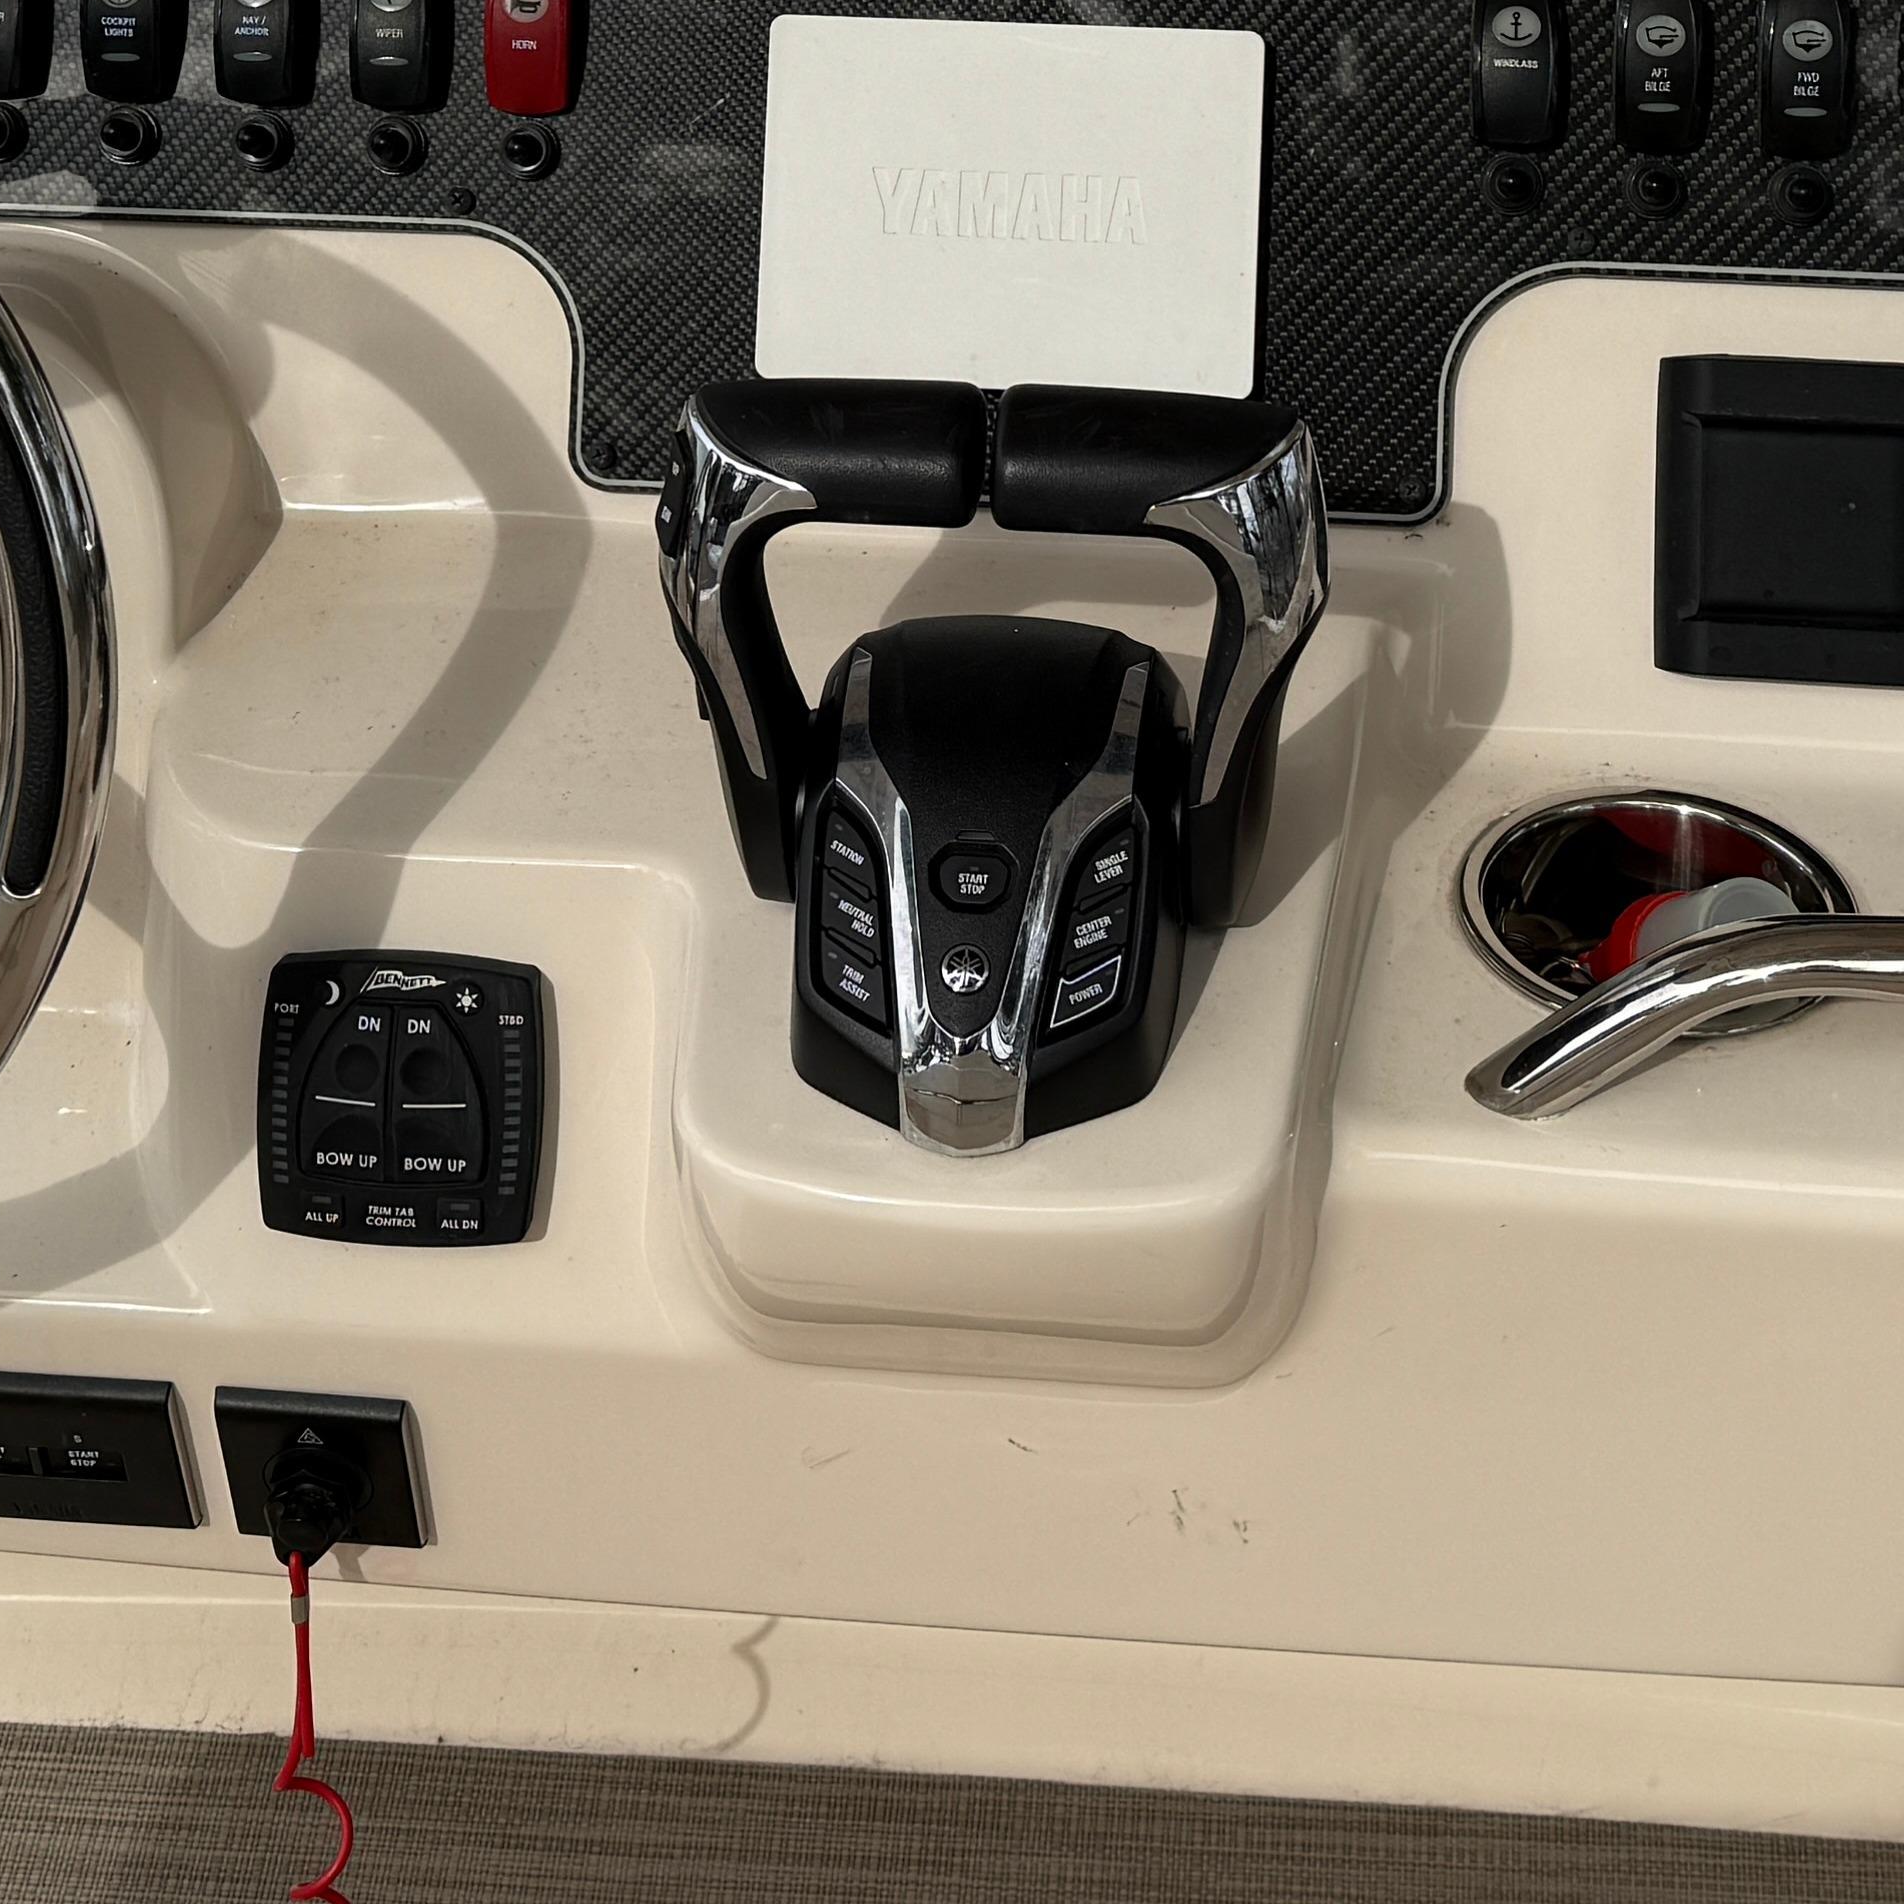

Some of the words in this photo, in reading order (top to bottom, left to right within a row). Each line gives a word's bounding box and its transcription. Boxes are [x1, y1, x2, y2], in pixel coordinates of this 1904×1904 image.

[101, 16, 136, 26] COCKPIT
[104, 27, 134, 37] LIGHTS
[234, 27, 269, 36] ANCHOR
[375, 28, 404, 39] WIPER
[512, 39, 537, 50] HORN
[1493, 58, 1539, 69] WINDLASS
[1651, 68, 1668, 78] AFT
[872, 167, 1149, 245] YAMAHA
[829, 840, 865, 867] STATION
[1095, 850, 1129, 872] SINGLE
[957, 872, 989, 885] START
[1094, 864, 1124, 885] LEVER
[959, 883, 985, 895] STOP
[837, 899, 874, 927] NEUTRAL
[851, 918, 875, 939] HOLD
[1075, 915, 1113, 937] CENTER
[1073, 928, 1109, 950] ENGINE
[842, 964, 865, 986] TRIM
[839, 978, 870, 1002] ASSIST
[1069, 983, 1103, 1005] POWER
[274, 1002, 299, 1014] PORT
[358, 1016, 381, 1032] DN
[407, 1019, 431, 1035] DN
[498, 1014, 524, 1026] STBD
[316, 1152, 353, 1167] BOW
[358, 1154, 377, 1168] UP
[404, 1158, 442, 1172] BOW
[447, 1159, 466, 1173] UP
[305, 1211, 324, 1222] ALL
[326, 1213, 339, 1224] UP
[368, 1205, 393, 1216] TRIM
[394, 1206, 414, 1217] TAB
[365, 1216, 416, 1228] CONTROL
[441, 1219, 459, 1229] ALL
[461, 1220, 478, 1230] DN
